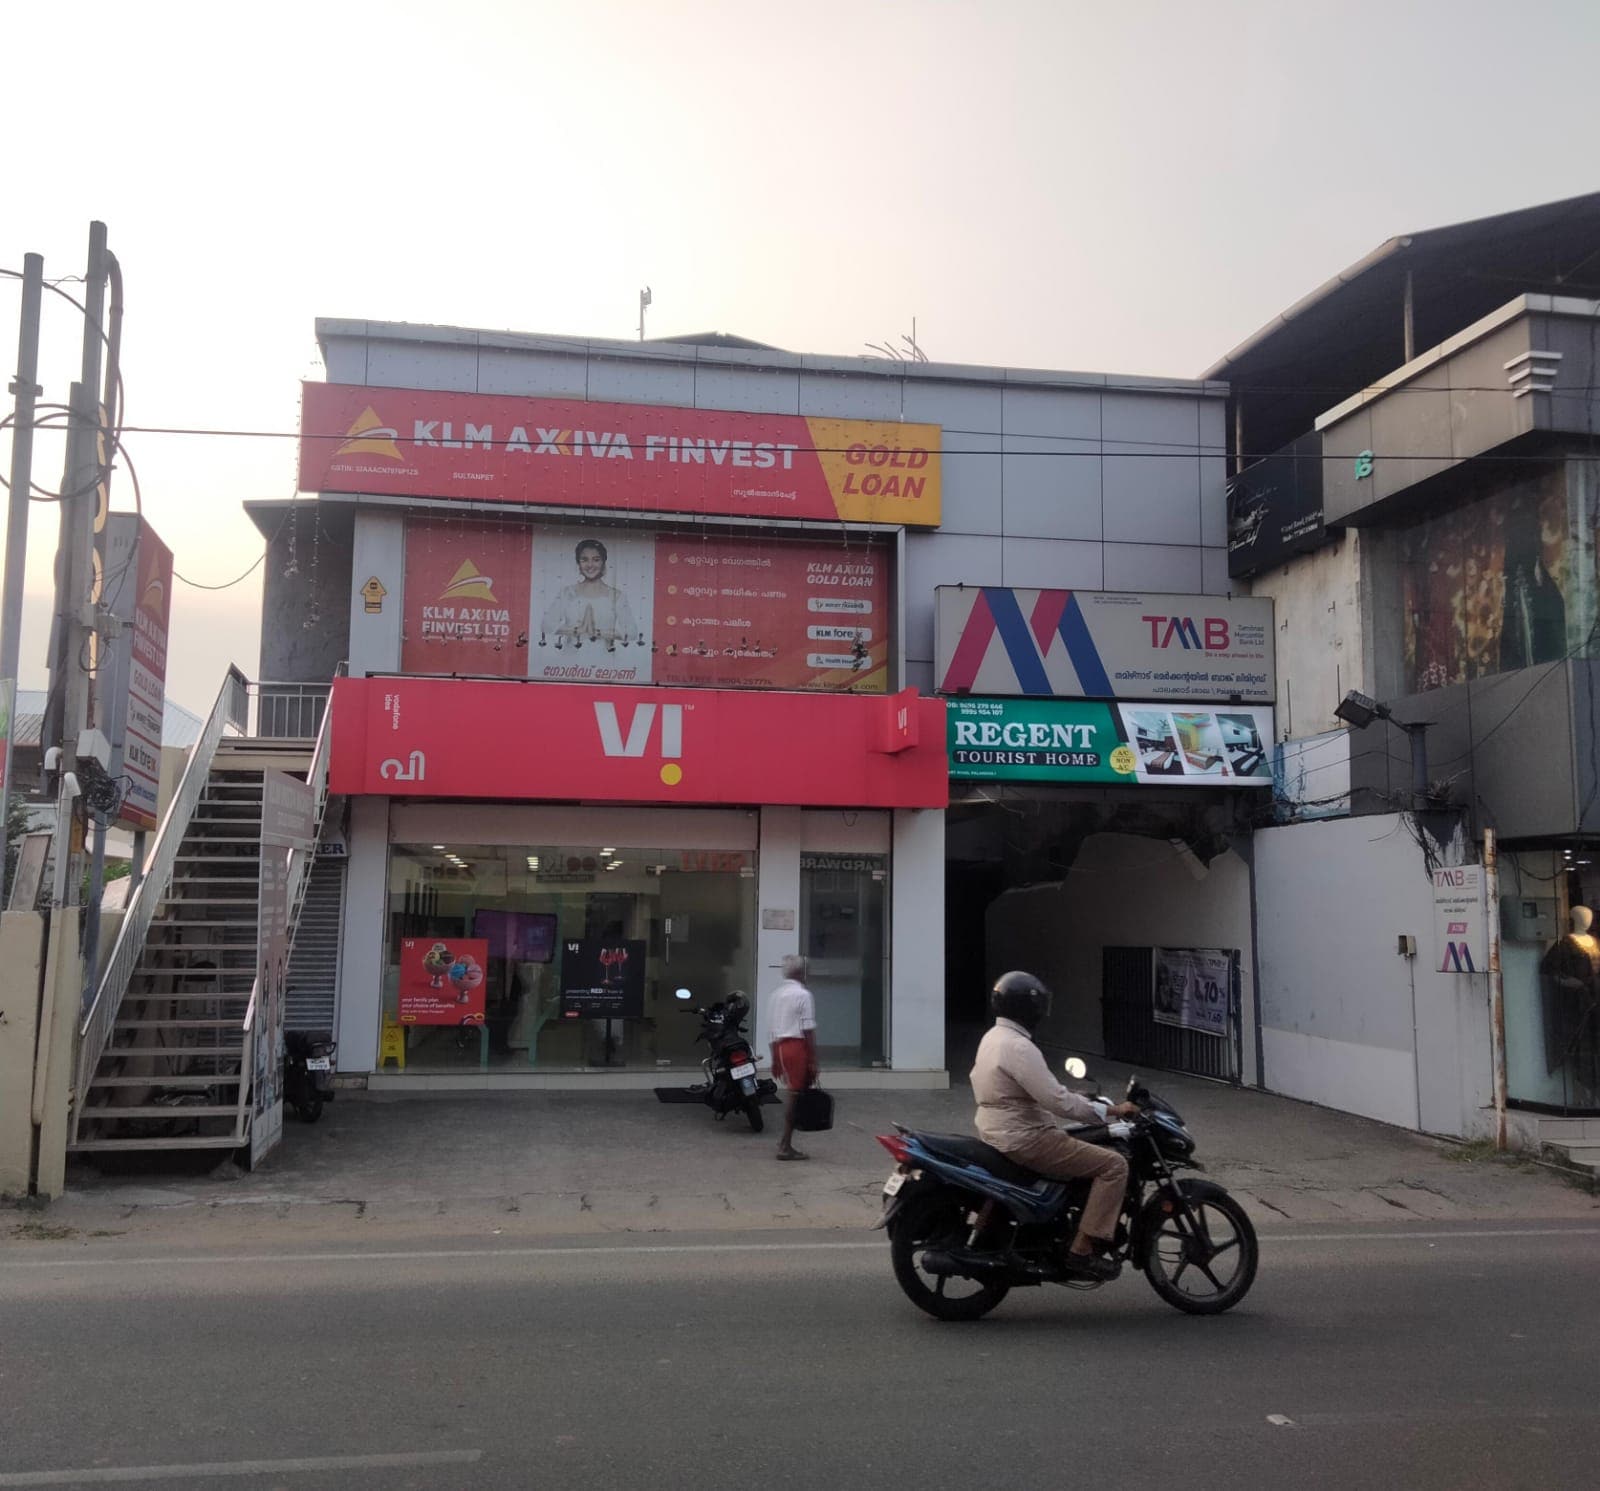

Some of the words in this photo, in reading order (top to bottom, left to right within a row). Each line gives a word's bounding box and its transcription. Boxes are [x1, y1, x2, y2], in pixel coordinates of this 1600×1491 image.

[413, 420, 493, 450] KLM
[645, 435, 799, 469] FINVEST
[845, 443, 929, 469] GOLD
[453, 471, 494, 480] SULTANPET
[842, 473, 926, 498] LOAN
[808, 563, 832, 573] KLM
[807, 575, 839, 584] GOLD
[842, 577, 873, 586] LOAN
[423, 607, 455, 619] KLM
[485, 623, 510, 636] LTD
[1142, 616, 1230, 650] TMB
[955, 721, 1097, 748] REGENT
[957, 750, 1037, 764] TOURIST
[1046, 754, 1097, 766] HOME
[1434, 871, 1465, 888] TMB
